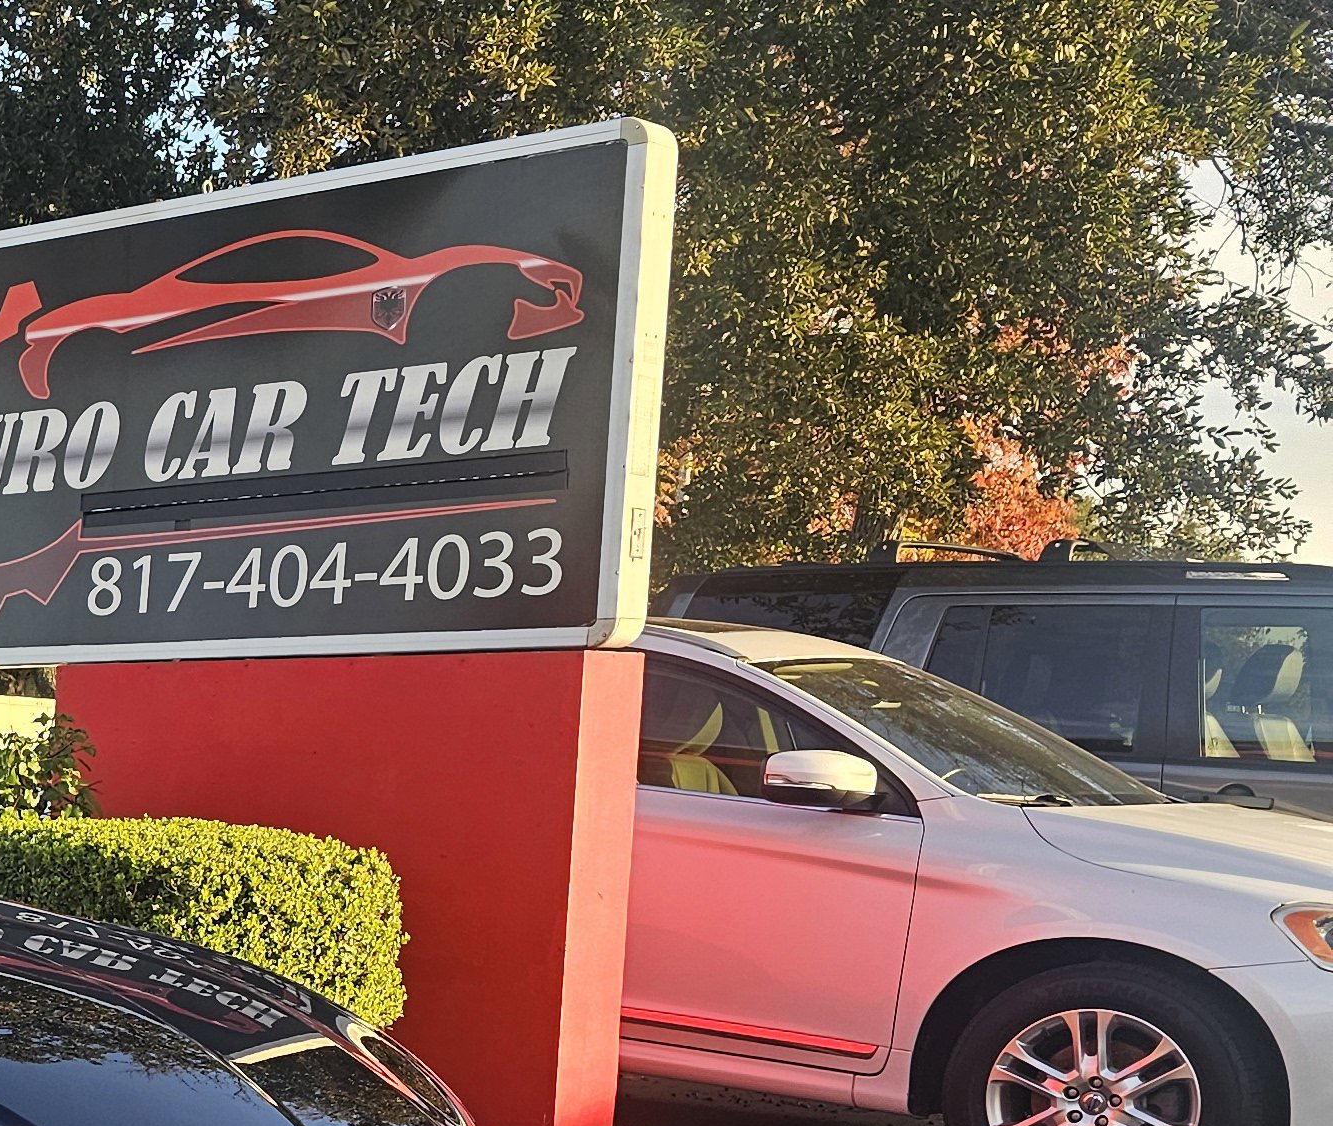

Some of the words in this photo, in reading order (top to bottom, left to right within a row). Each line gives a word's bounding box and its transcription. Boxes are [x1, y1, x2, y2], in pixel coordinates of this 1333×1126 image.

[144, 380, 307, 483] CAR
[332, 346, 577, 466] TECH
[87, 527, 563, 617] 817-404-4033
